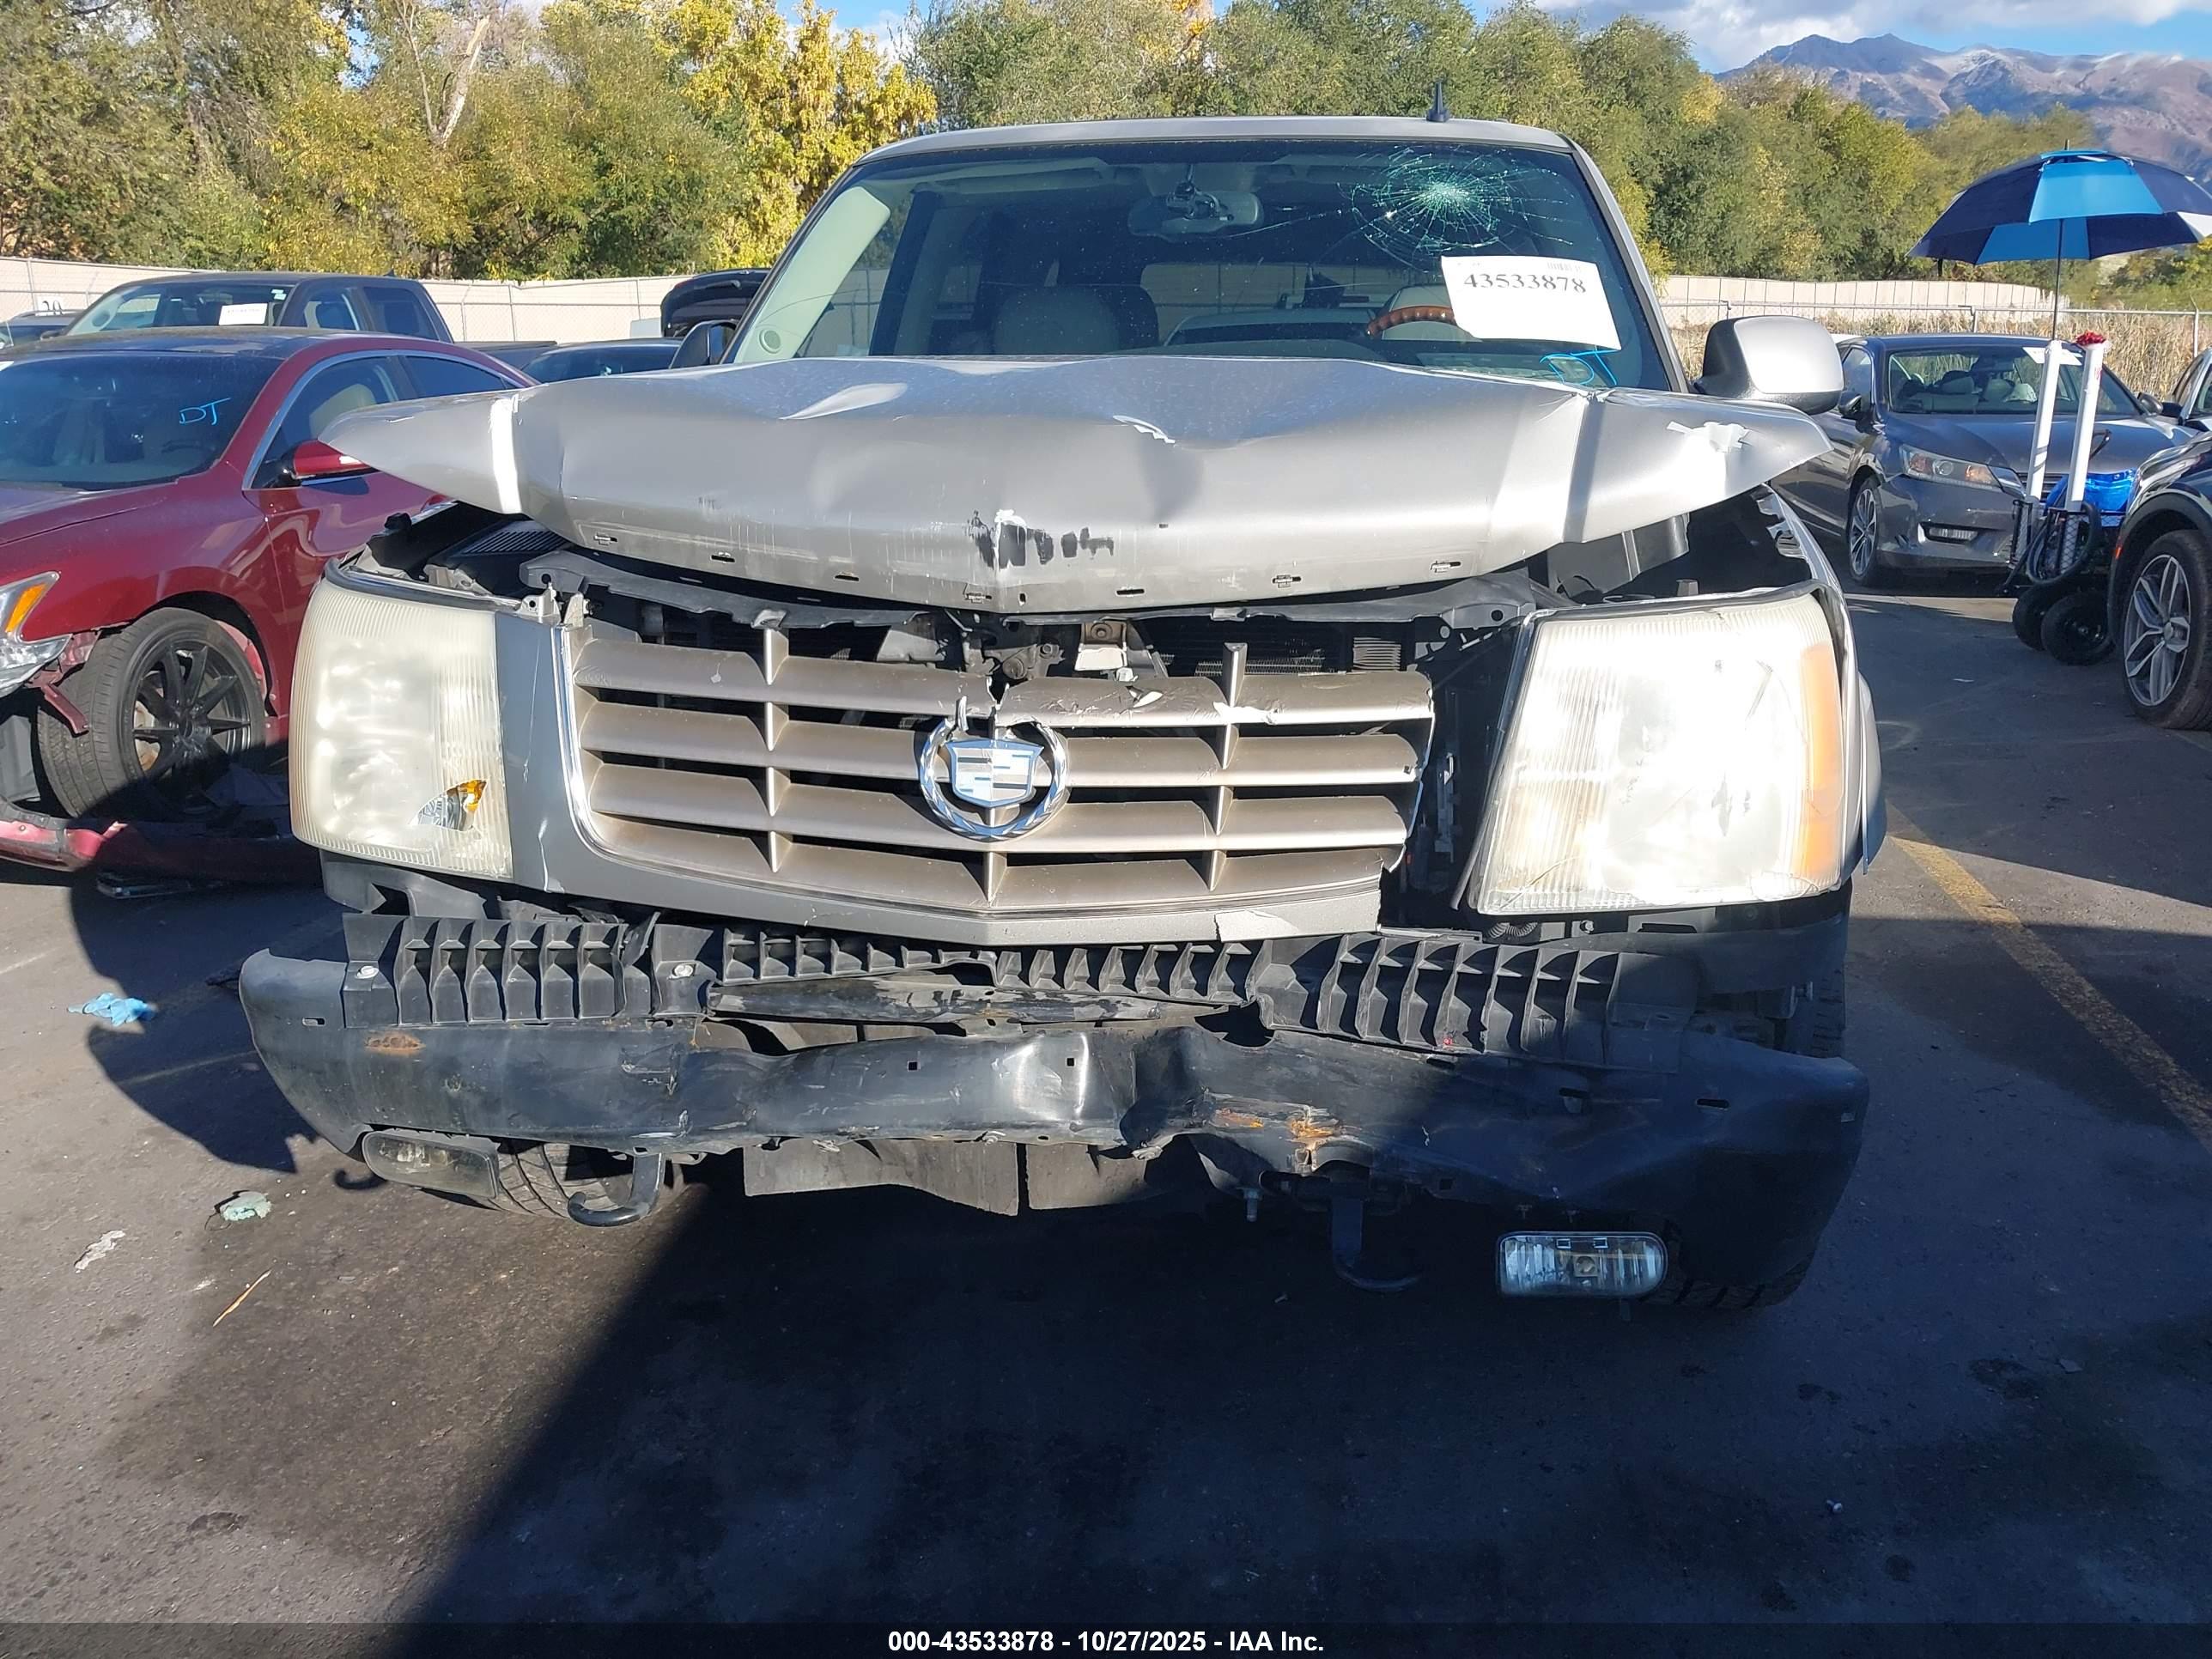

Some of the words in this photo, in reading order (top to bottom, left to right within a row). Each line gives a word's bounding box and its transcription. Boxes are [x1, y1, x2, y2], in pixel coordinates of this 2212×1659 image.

[1463, 272, 1587, 294] 43533878
[1539, 345, 1620, 386] DT
[179, 397, 233, 426] DT
